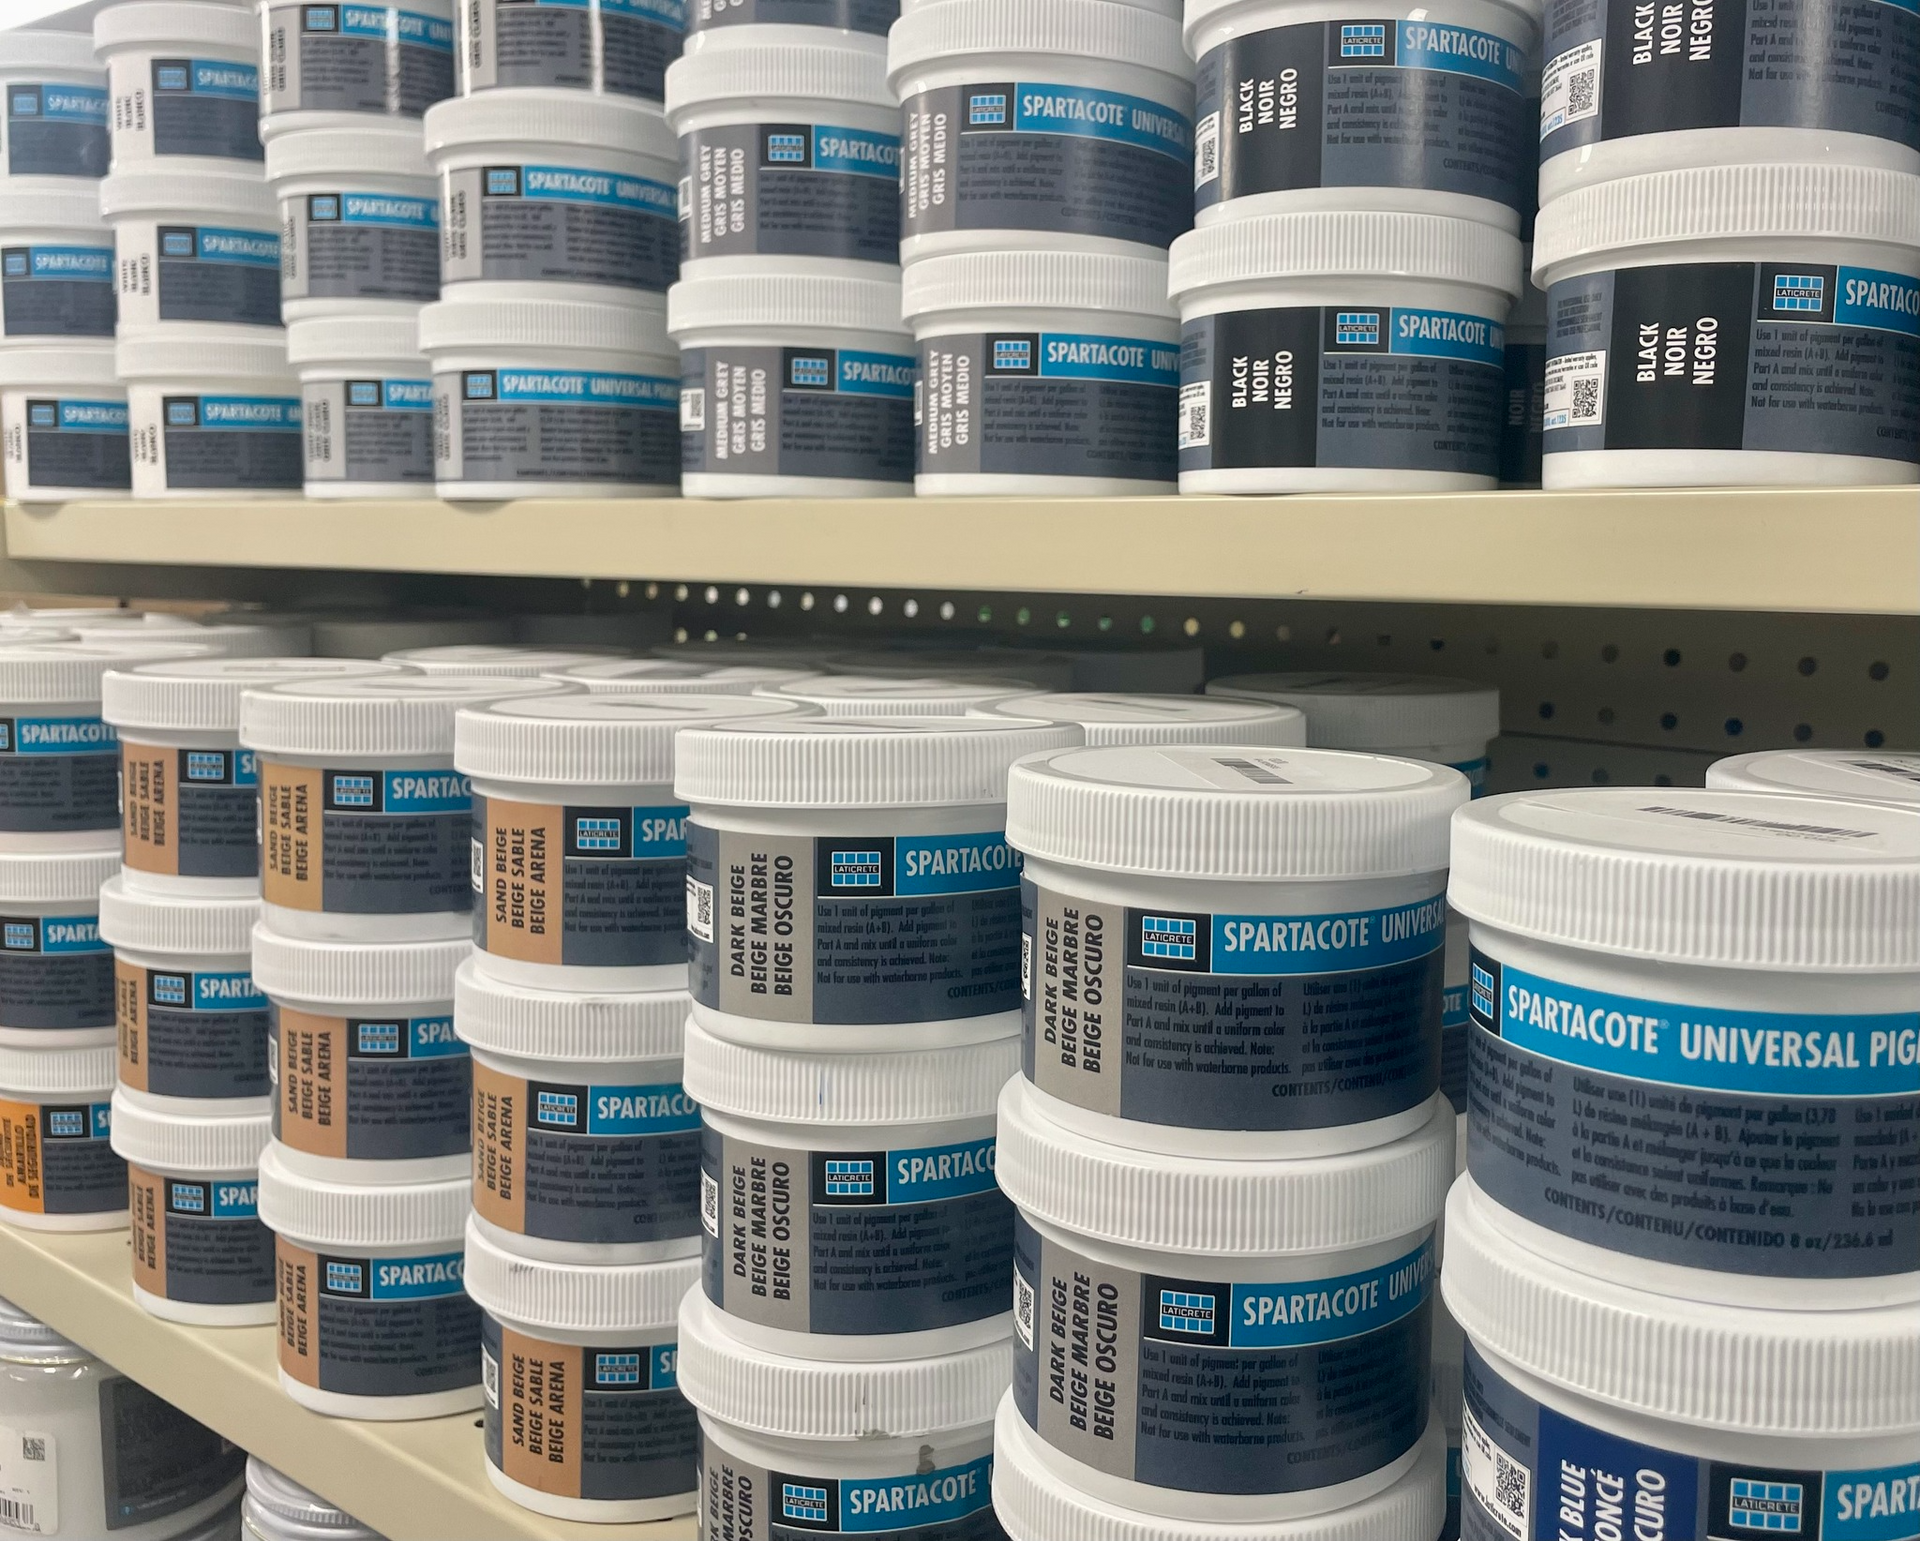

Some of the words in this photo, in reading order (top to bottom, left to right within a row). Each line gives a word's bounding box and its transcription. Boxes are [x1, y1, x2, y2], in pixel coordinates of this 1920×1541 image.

[1343, 37, 1383, 45] LATICRETE
[1632, 1, 1655, 66] BLACK
[1660, 2, 1684, 55] NOIR
[1238, 78, 1255, 134] BLACK
[1258, 79, 1275, 123] NOIR
[1279, 67, 1298, 130] NEGRO
[909, 112, 919, 150] GREY
[920, 113, 932, 169] MOYEN
[934, 113, 947, 163] MEDIO
[700, 145, 711, 182] GREY
[714, 147, 727, 199] MOYEN
[731, 148, 745, 195] MEDIO
[908, 156, 918, 219] MEDIUM
[932, 168, 945, 205] GRIS
[700, 185, 711, 243] MEDIUM
[731, 199, 745, 232] GRIS
[919, 174, 930, 210] GRIS
[714, 202, 727, 236] GRIS
[1776, 288, 1820, 298] LATICRETE
[1338, 325, 1378, 333] LATICRETE
[1399, 314, 1485, 346] SPARTACOTE
[1636, 322, 1659, 382] BLACK
[1664, 325, 1687, 376] NOIR
[1692, 316, 1718, 385] NEGRO
[716, 361, 729, 398] GREY
[930, 349, 940, 389] GREY
[956, 355, 970, 405] MEDIO
[1047, 342, 1144, 369] SPARTACOTE
[1274, 350, 1293, 410] NEGRO
[503, 374, 584, 394] SPARTACOTE
[732, 366, 746, 418] MOYEN
[751, 368, 766, 414] MEDIO
[941, 354, 953, 408] MOYEN
[1232, 355, 1248, 408] BLACK
[1252, 359, 1269, 402] NOIR
[715, 401, 728, 459] MEDIUM
[732, 421, 746, 454] GRIS
[751, 419, 766, 452] GRIS
[929, 392, 939, 454] MEDIUM
[940, 413, 952, 448] GRIS
[955, 409, 969, 445] GRIS
[281, 786, 291, 829] SABLE
[295, 784, 307, 835] ARENA
[281, 834, 291, 875] BEIGE
[296, 840, 308, 881] BEIGE
[496, 827, 507, 873] BEIGE
[511, 827, 524, 877] SABLE
[530, 827, 545, 884] ARENA
[833, 865, 879, 873] LATICRETE
[496, 878, 507, 923] SAND
[511, 882, 524, 928] BEIGE
[530, 888, 545, 935] BEIGE
[731, 865, 745, 918] BEIGE
[751, 853, 767, 935] MARBRE
[774, 855, 793, 936] OSCURO
[731, 924, 745, 977] DARK
[1046, 917, 1059, 979] BEIGE
[1062, 907, 1079, 1002] MARBRE
[1084, 914, 1103, 1006] OSCURO
[1144, 932, 1193, 944] LATICRETE
[751, 940, 767, 994] BEIGE
[774, 942, 793, 996] BEIGE
[1127, 976, 1142, 990] Use
[1152, 980, 1169, 992] unit
[1172, 980, 1181, 993] of
[1184, 982, 1220, 1000] pigment
[1224, 985, 1238, 1000] per
[1241, 982, 1270, 1000] gallon
[1272, 982, 1282, 997] of
[1044, 984, 1058, 1046] DARK
[1127, 997, 1152, 1011] mixed
[1155, 1000, 1176, 1012] resin
[1215, 1001, 1232, 1016] Add
[1236, 1002, 1272, 1020] pigment
[1276, 1004, 1284, 1016] to
[302, 1032, 312, 1076] SABLE
[318, 1032, 331, 1083] ARENA
[1061, 1006, 1076, 1069] BEIGE
[1083, 1010, 1101, 1075] BEIGE
[1680, 1022, 1859, 1070] UNIVERSAL
[1126, 1051, 1140, 1065] Not
[1142, 1056, 1154, 1068] for
[1157, 1060, 1172, 1070] use
[1174, 1057, 1193, 1072] with
[1196, 1060, 1248, 1075] waterborne
[302, 1079, 313, 1121] BEIGE
[318, 1086, 331, 1127] BEIGE
[487, 1092, 497, 1142] SABLE
[500, 1096, 512, 1151] ARENA
[487, 1145, 497, 1191] BEIGE
[500, 1155, 512, 1200] BEIGE
[733, 1166, 746, 1219] BEIGE
[827, 1173, 871, 1182] LATICRETE
[751, 1156, 766, 1239] MARBRE
[772, 1162, 790, 1241] OSCURO
[733, 1223, 746, 1278] DARK
[751, 1243, 766, 1297] BEIGE
[773, 1247, 790, 1301] BEIGE
[286, 1261, 294, 1303] SABLE
[296, 1265, 307, 1314] ARENA
[286, 1309, 294, 1347] BEIGE
[1052, 1277, 1068, 1340] BEIGE
[1072, 1272, 1091, 1368] MARBRE
[1096, 1283, 1118, 1374] OSCURO
[1162, 1306, 1212, 1319] LATICRETE
[297, 1313, 307, 1356] BEIGE
[512, 1354, 524, 1400] BEIGE
[529, 1358, 543, 1407] SABLE
[549, 1361, 564, 1415] ARENA
[1050, 1342, 1066, 1405] DARK
[513, 1403, 524, 1447] SAND
[1070, 1369, 1087, 1432] BEIGE
[1093, 1380, 1115, 1441] BEIGE
[530, 1410, 543, 1455] BEIGE
[549, 1418, 564, 1464] BEIGE
[709, 1467, 719, 1520] BEIGE
[785, 1497, 825, 1509] LATICRETE
[1558, 1459, 1587, 1528] BLUE
[1590, 1468, 1624, 1541] ONCÉ
[1733, 1498, 1798, 1514] LATICRETE
